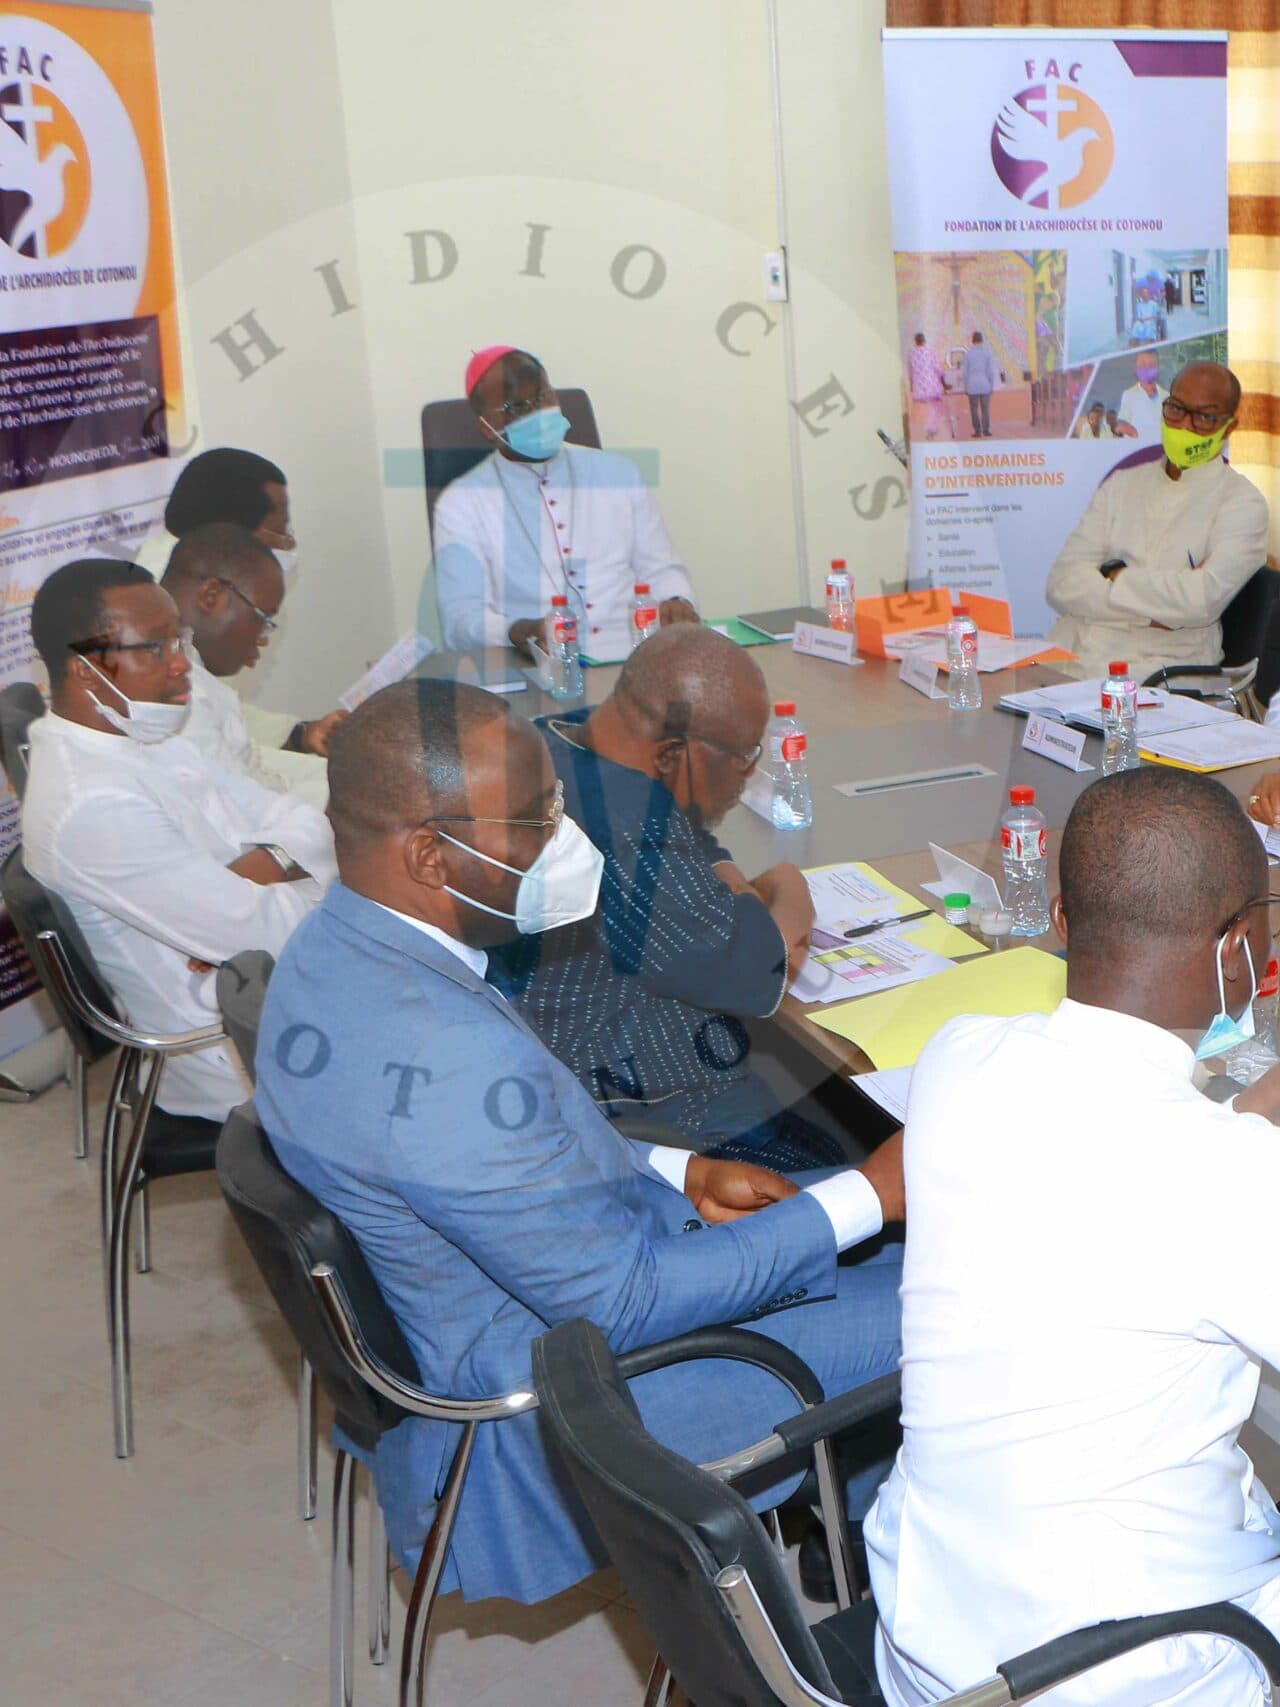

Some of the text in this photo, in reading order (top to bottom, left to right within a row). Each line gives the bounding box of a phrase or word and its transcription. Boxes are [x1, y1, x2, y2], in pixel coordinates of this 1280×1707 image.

[1024, 58, 1083, 82] FAC
[945, 216, 1163, 232] FONDATION DE L'ARCHIDIOCÈSE DE COTONOU
[97, 265, 138, 283] COTONOU
[11, 341, 66, 361] Fondation
[924, 452, 1047, 470] NOS DOMAINES
[924, 471, 1066, 489] D'INTERVENTIONS
